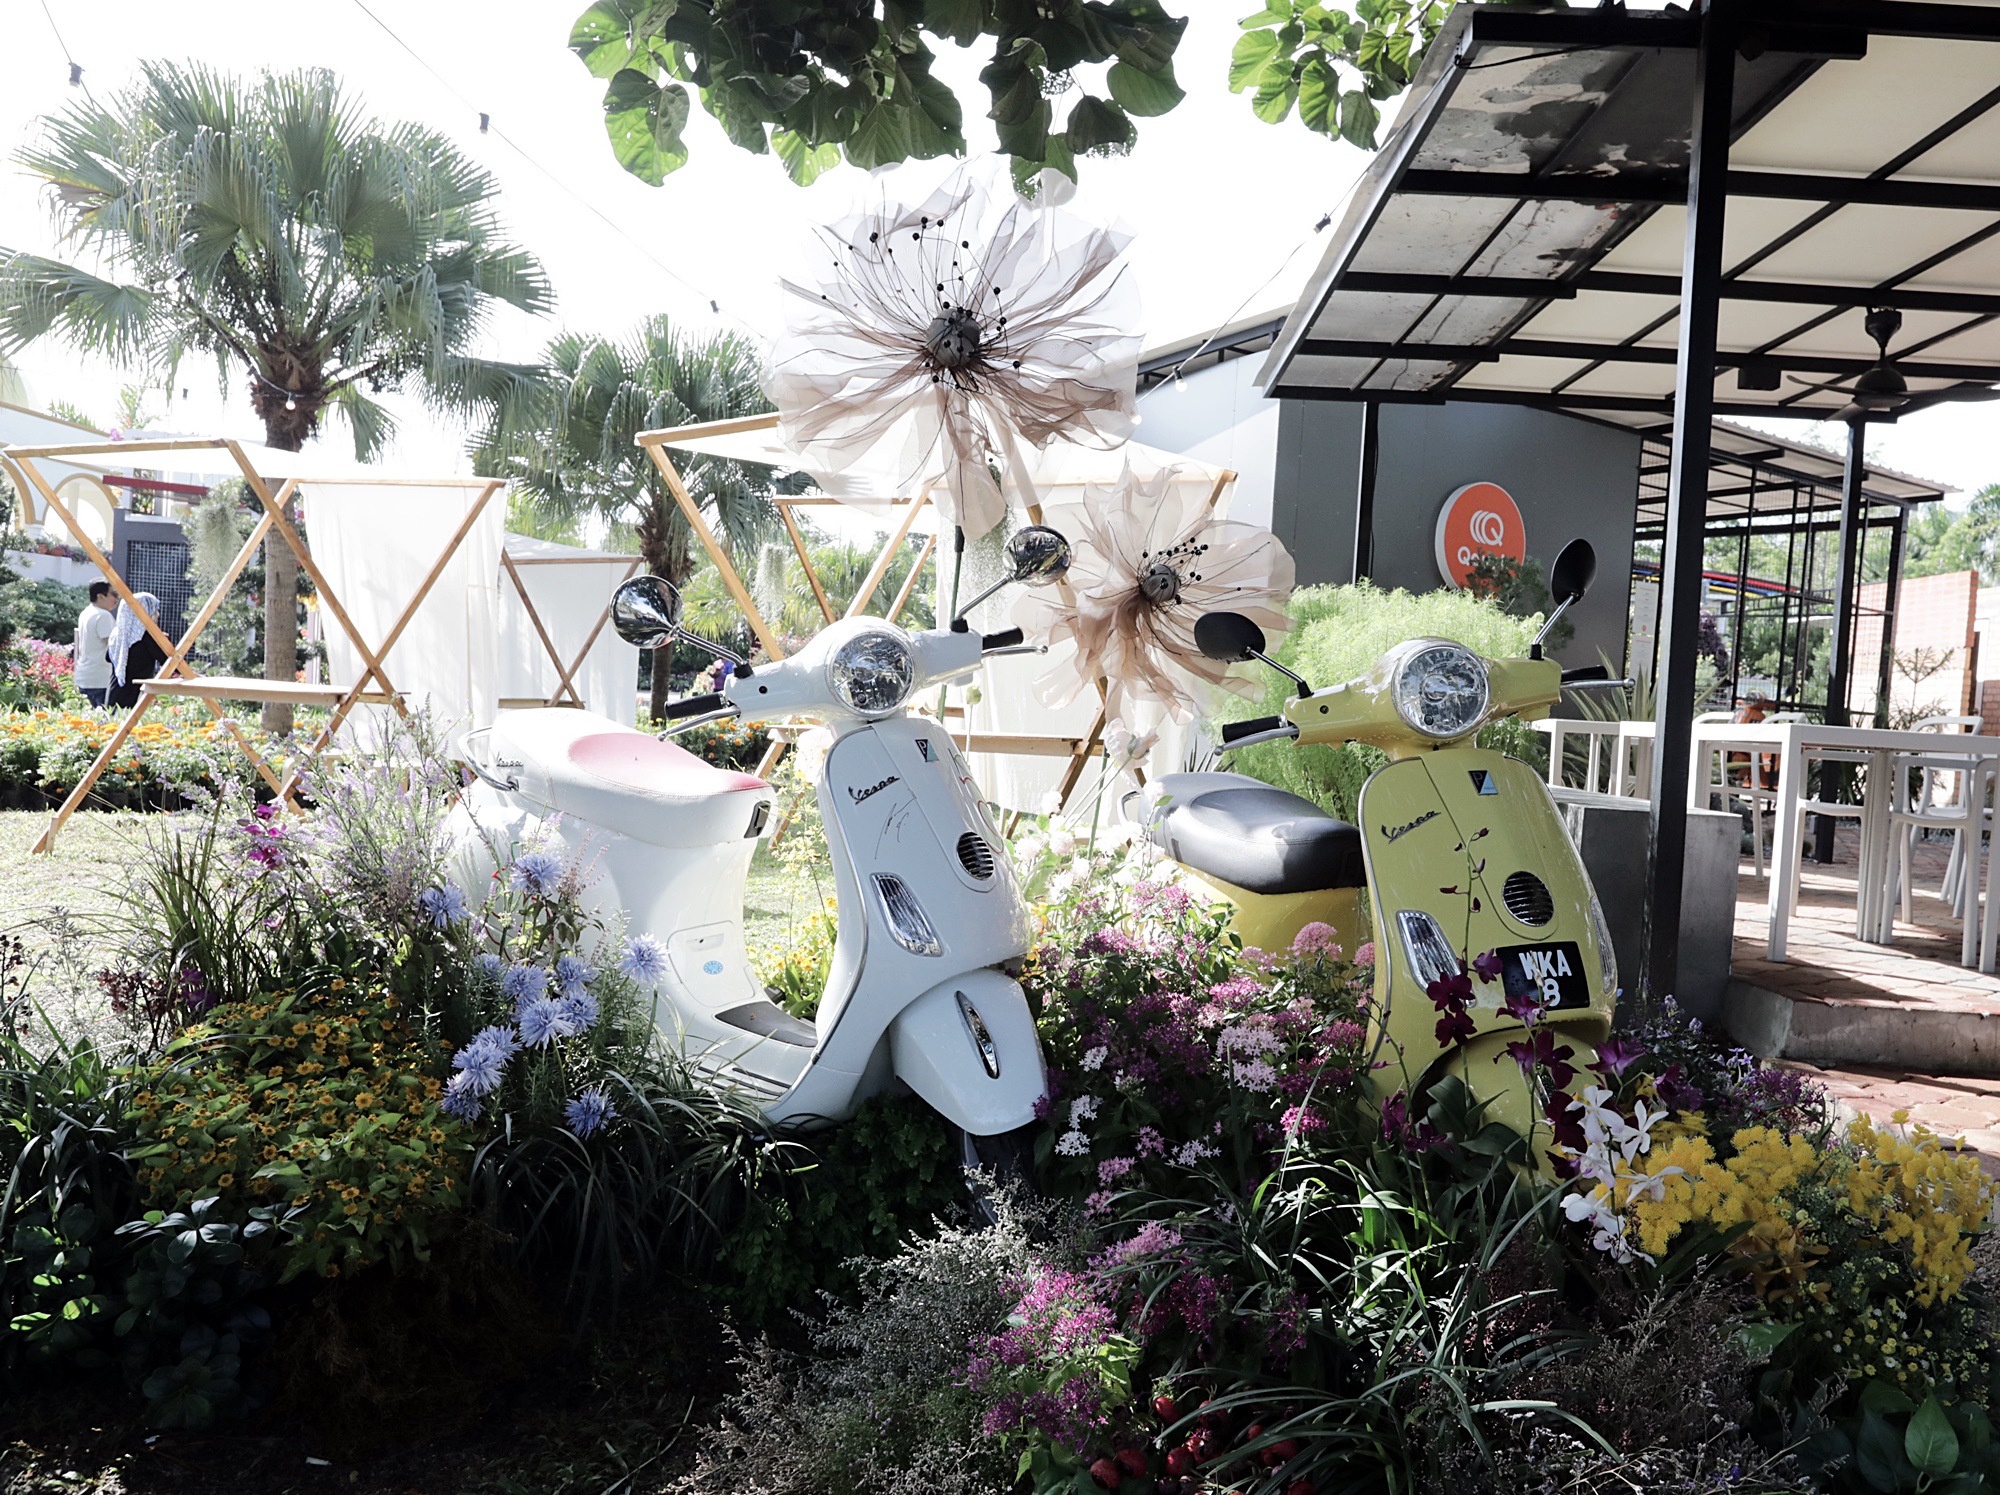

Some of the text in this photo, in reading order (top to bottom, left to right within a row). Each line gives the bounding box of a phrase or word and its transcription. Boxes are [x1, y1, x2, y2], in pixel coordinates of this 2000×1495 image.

[848, 775, 900, 805] Vespa
[1381, 810, 1441, 844] Vespa
[1518, 949, 1572, 980] WKA
[1542, 978, 1561, 1007] 8
